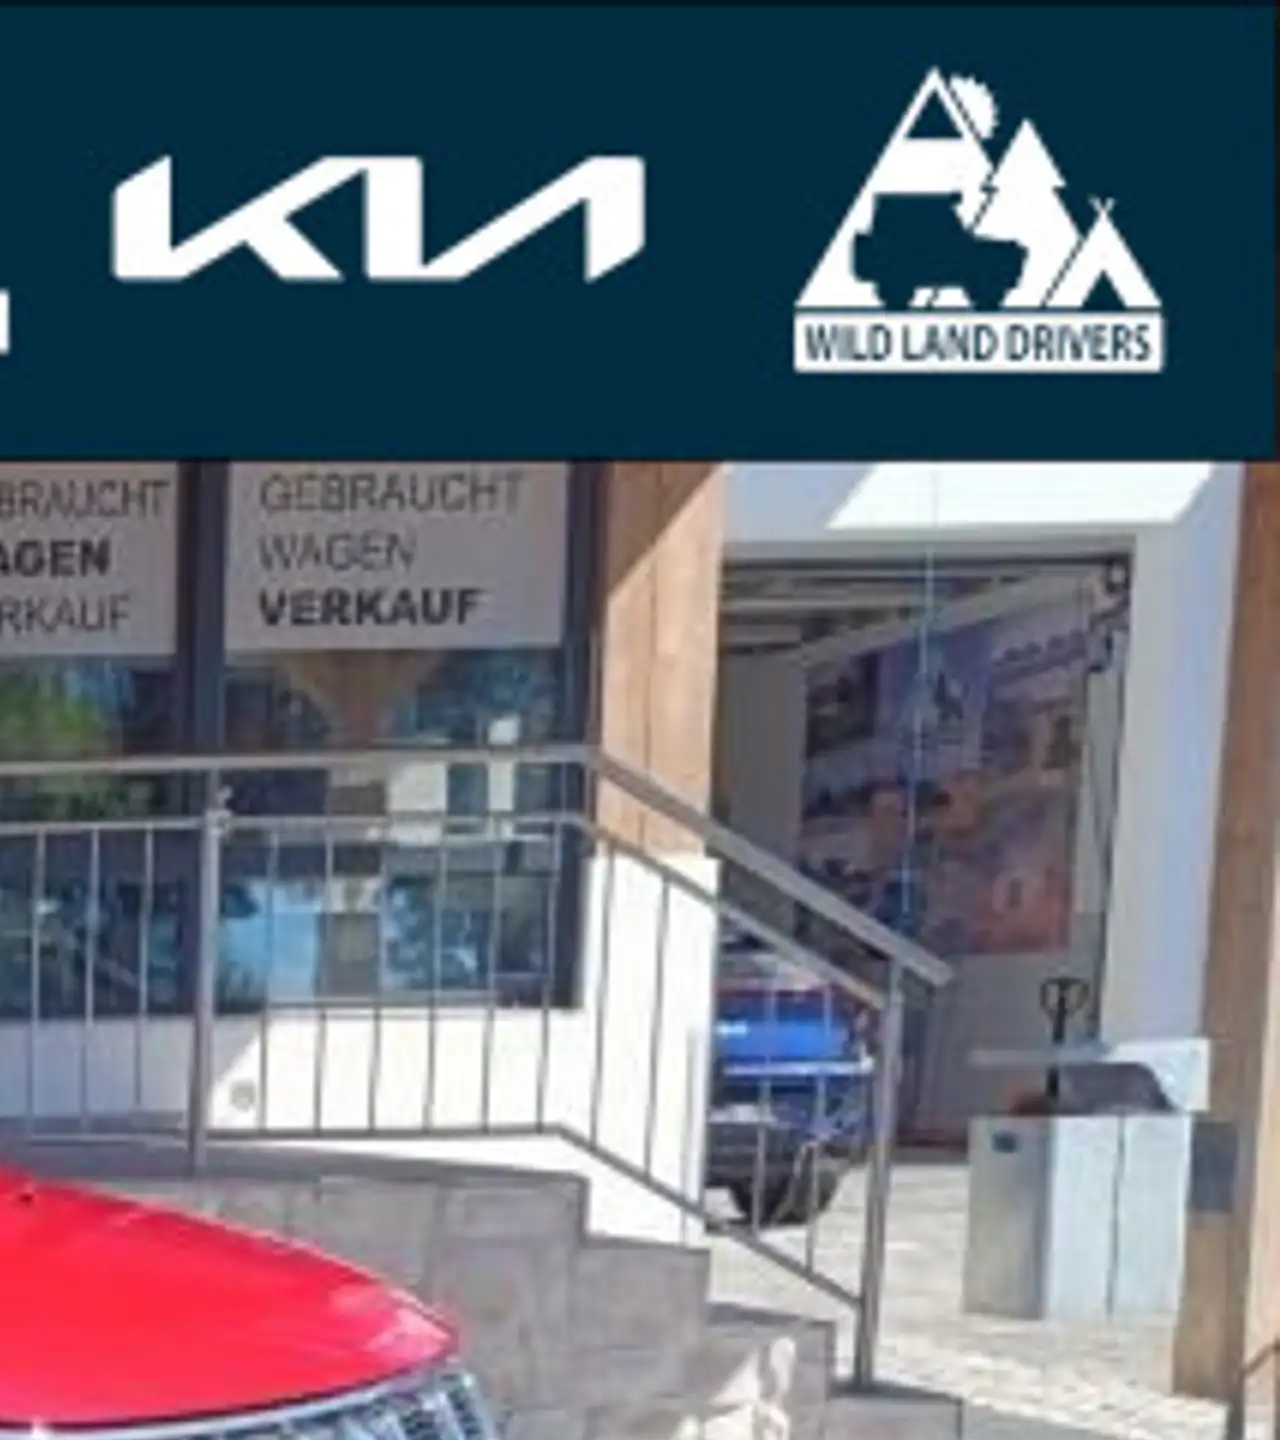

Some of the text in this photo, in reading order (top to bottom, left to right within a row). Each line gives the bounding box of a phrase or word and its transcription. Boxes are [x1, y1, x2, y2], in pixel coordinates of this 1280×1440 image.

[257, 471, 526, 514] GEBRAUCHT
[257, 529, 419, 573] WAGEN
[257, 586, 489, 627] VERKAUF
